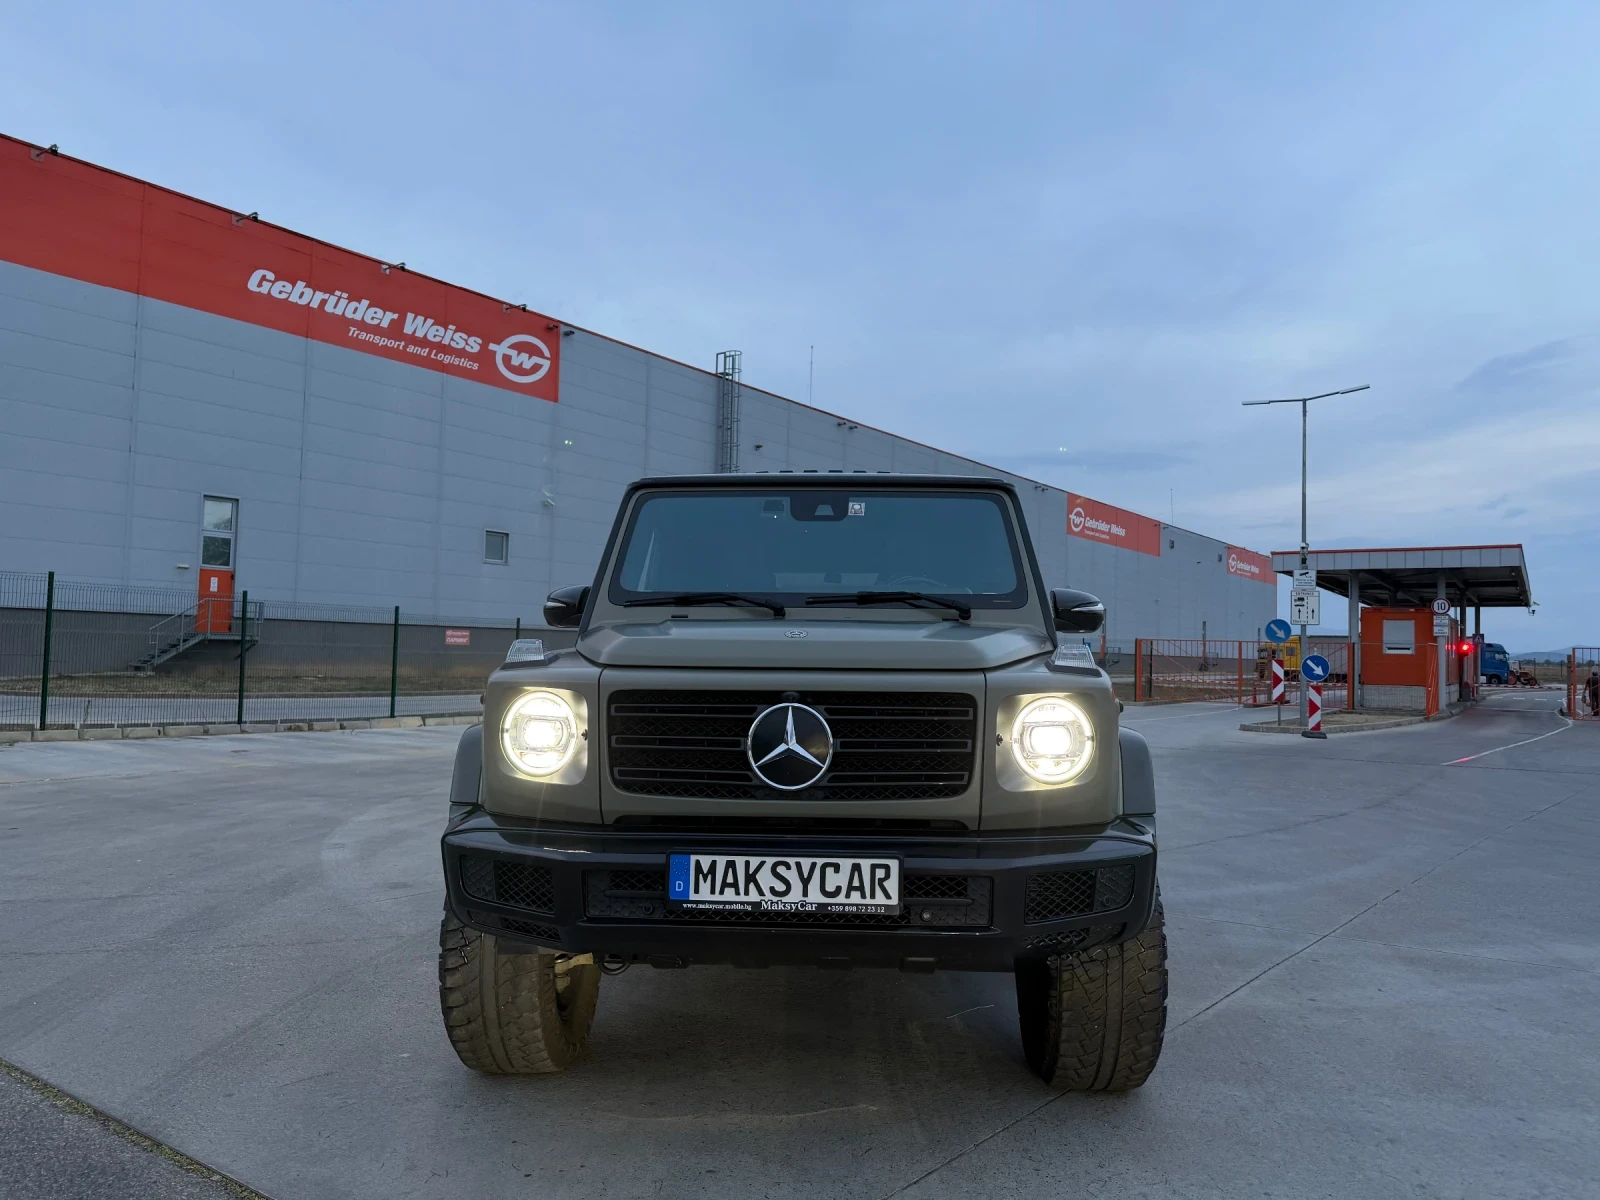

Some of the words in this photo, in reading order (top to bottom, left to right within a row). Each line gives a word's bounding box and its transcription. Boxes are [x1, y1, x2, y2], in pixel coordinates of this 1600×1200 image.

[247, 268, 399, 328] Gebrüder
[403, 312, 482, 353] Weiss
[347, 326, 405, 351] Transport
[406, 344, 429, 357] and
[430, 350, 479, 371] Logistics
[1436, 602, 1446, 611] 10
[693, 858, 893, 900] MAKSYCAR
[675, 880, 684, 892] D
[682, 903, 752, 911] www.maksycar.mobile.bg
[760, 900, 817, 912] MaksyCar
